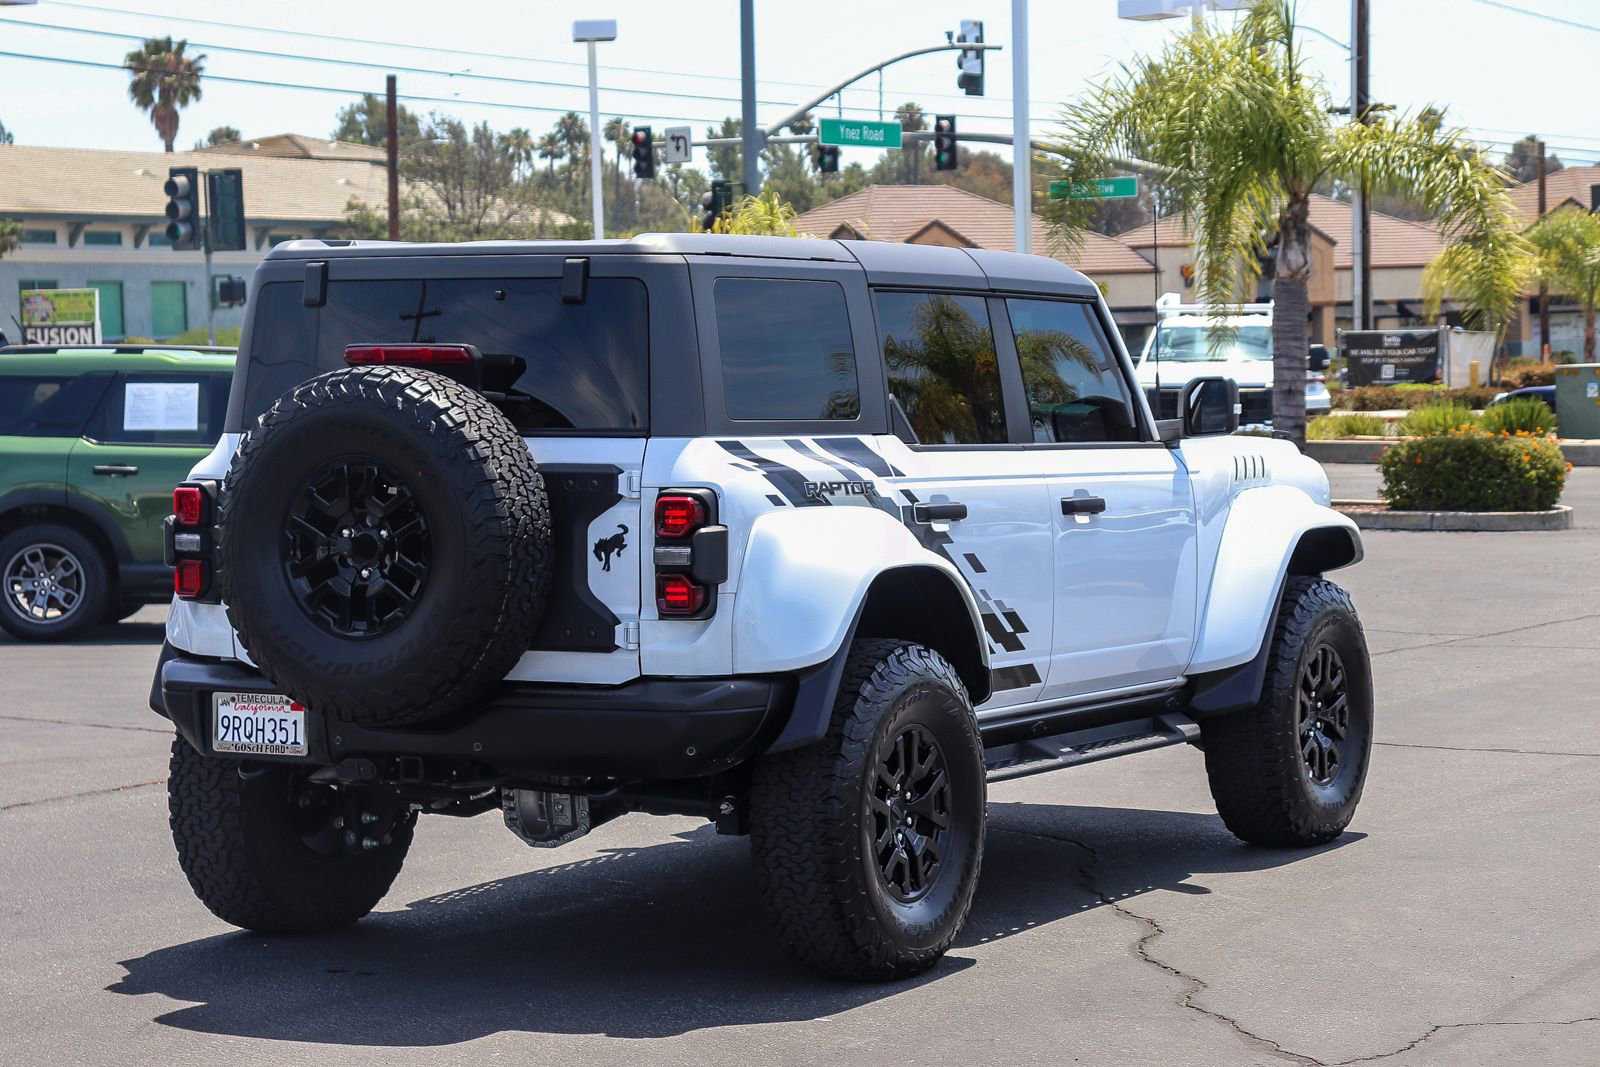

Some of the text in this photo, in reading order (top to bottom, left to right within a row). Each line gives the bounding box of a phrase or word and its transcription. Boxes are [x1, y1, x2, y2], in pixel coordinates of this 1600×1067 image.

[840, 124, 884, 141] Ynez Road
[26, 327, 93, 345] FUSION
[804, 480, 880, 503] RAPTOR
[219, 698, 231, 706] JAN
[236, 694, 285, 704] TEMECULA
[233, 702, 290, 715] California
[221, 715, 301, 745] 9RQH351
[264, 744, 286, 754] FORD
